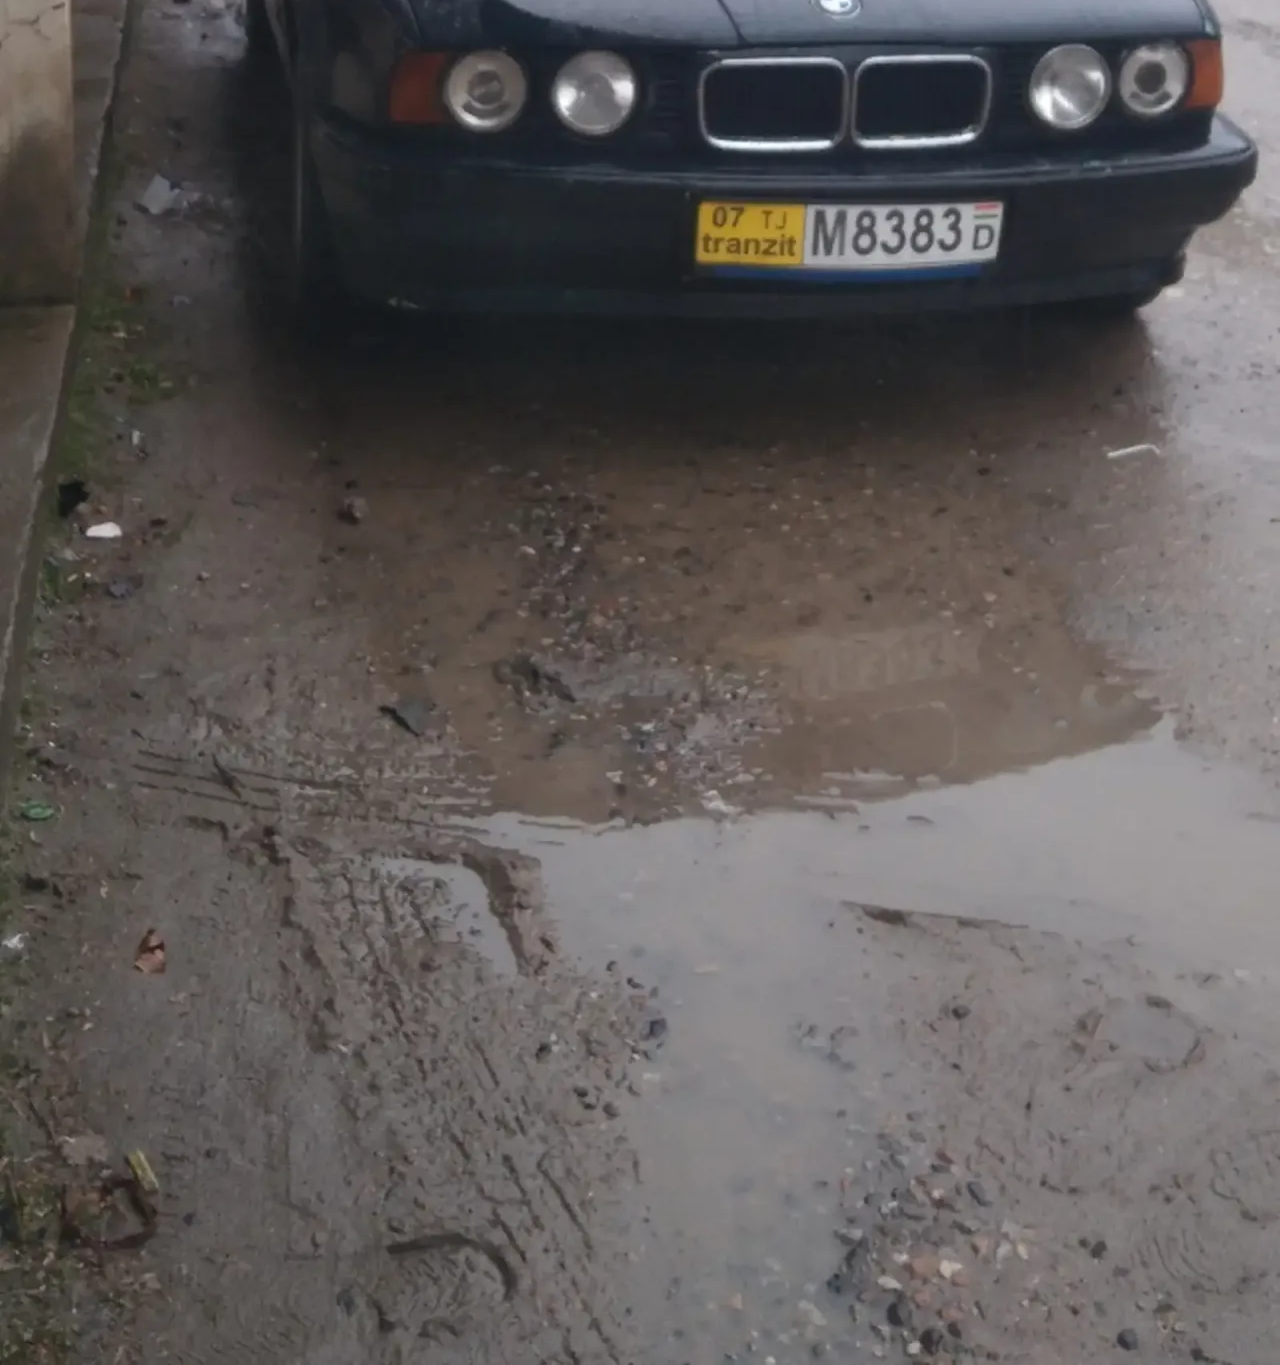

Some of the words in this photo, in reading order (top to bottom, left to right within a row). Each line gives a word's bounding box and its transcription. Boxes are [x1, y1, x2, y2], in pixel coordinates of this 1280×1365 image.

[712, 206, 744, 228] 07
[762, 210, 788, 230] TJ
[812, 208, 962, 256] M8383
[973, 224, 995, 250] D
[702, 234, 797, 257] tranzit
